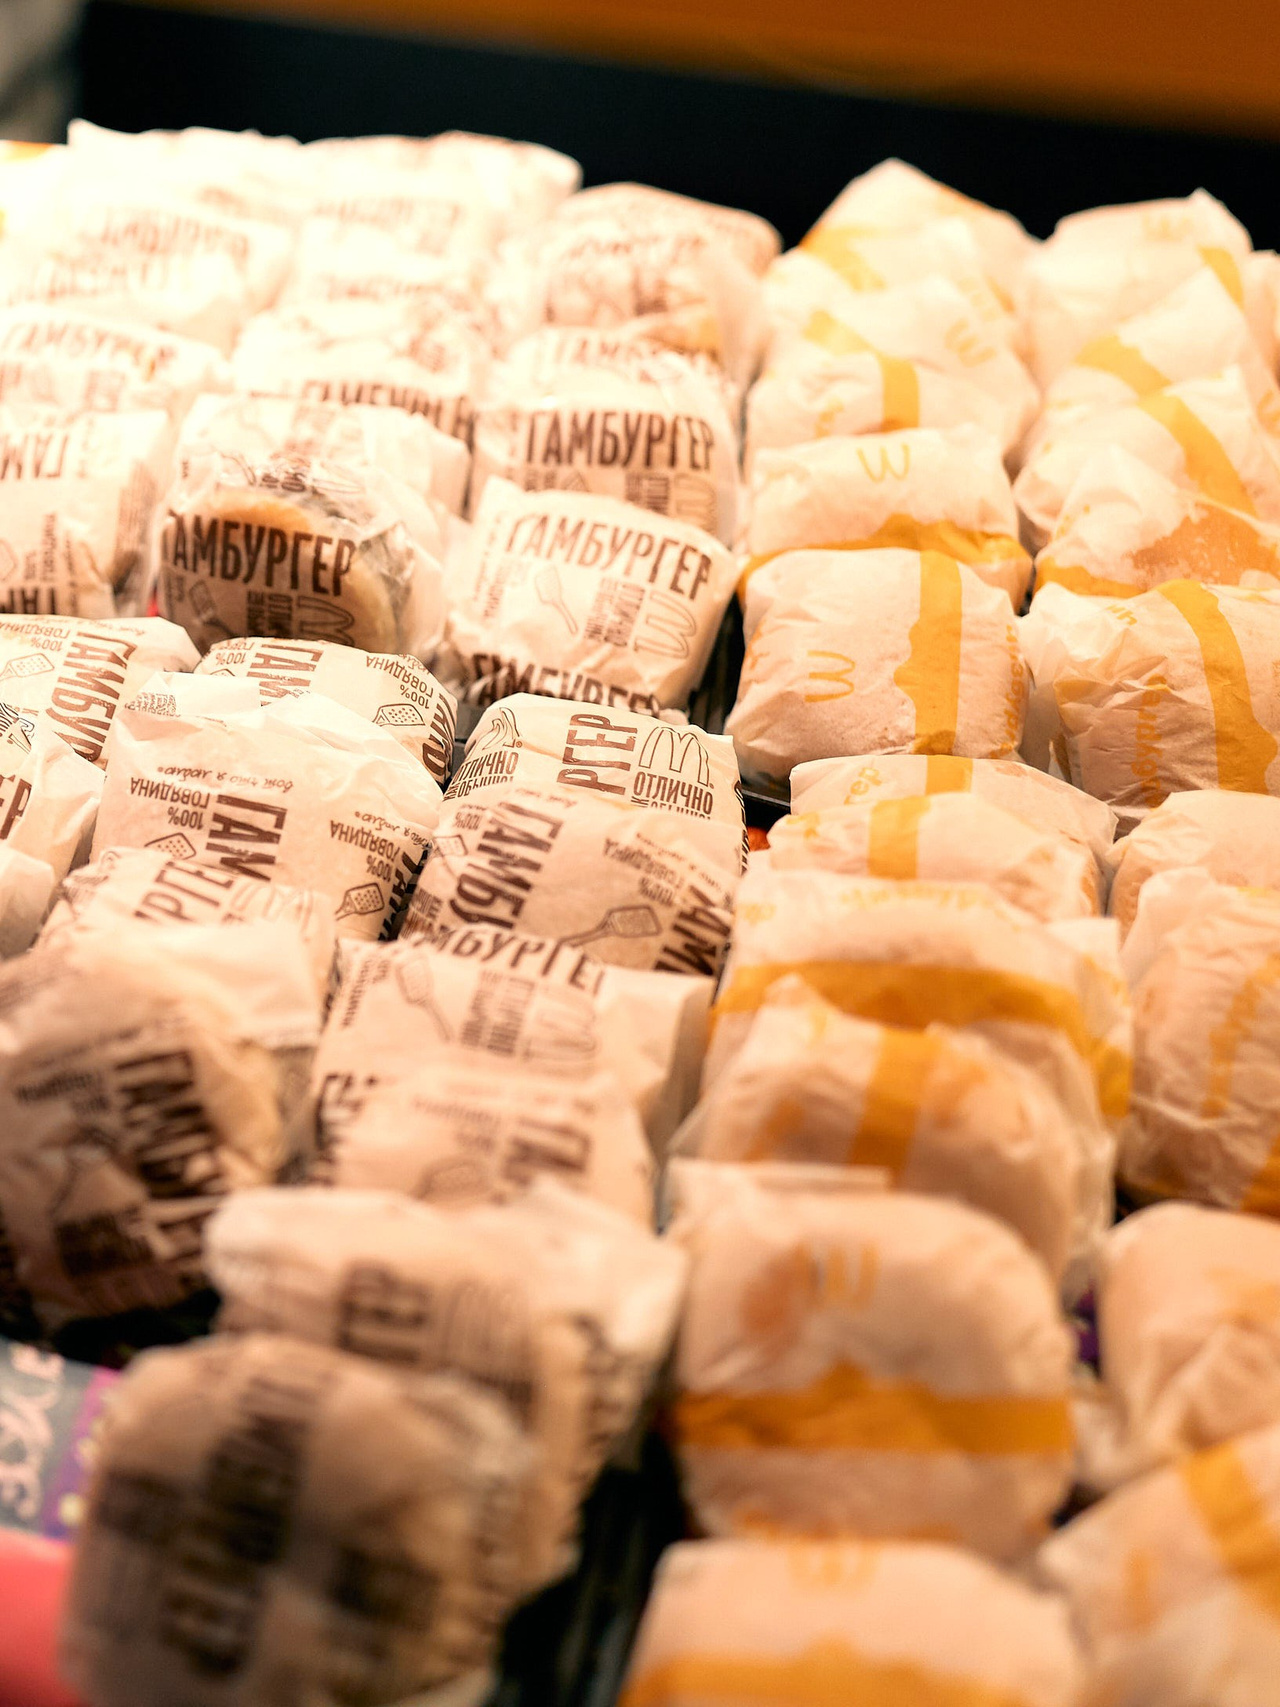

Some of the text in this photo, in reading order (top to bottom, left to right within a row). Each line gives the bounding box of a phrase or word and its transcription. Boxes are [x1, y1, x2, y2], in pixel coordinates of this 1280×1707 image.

[525, 410, 715, 472] ГАМБУРГЕР
[506, 511, 713, 602] ГАМБУРГЕР
[30, 635, 65, 653] 100%
[215, 651, 248, 665] 100%
[365, 654, 435, 698] ГОВЯДИНА
[400, 682, 431, 710] 100%
[130, 776, 212, 809] ГОВЯДИНА
[633, 770, 714, 816] ОТЛИЧНО
[167, 806, 204, 831] 100%
[329, 820, 401, 864] ГОВЯДИНА
[366, 854, 394, 883] 100%
